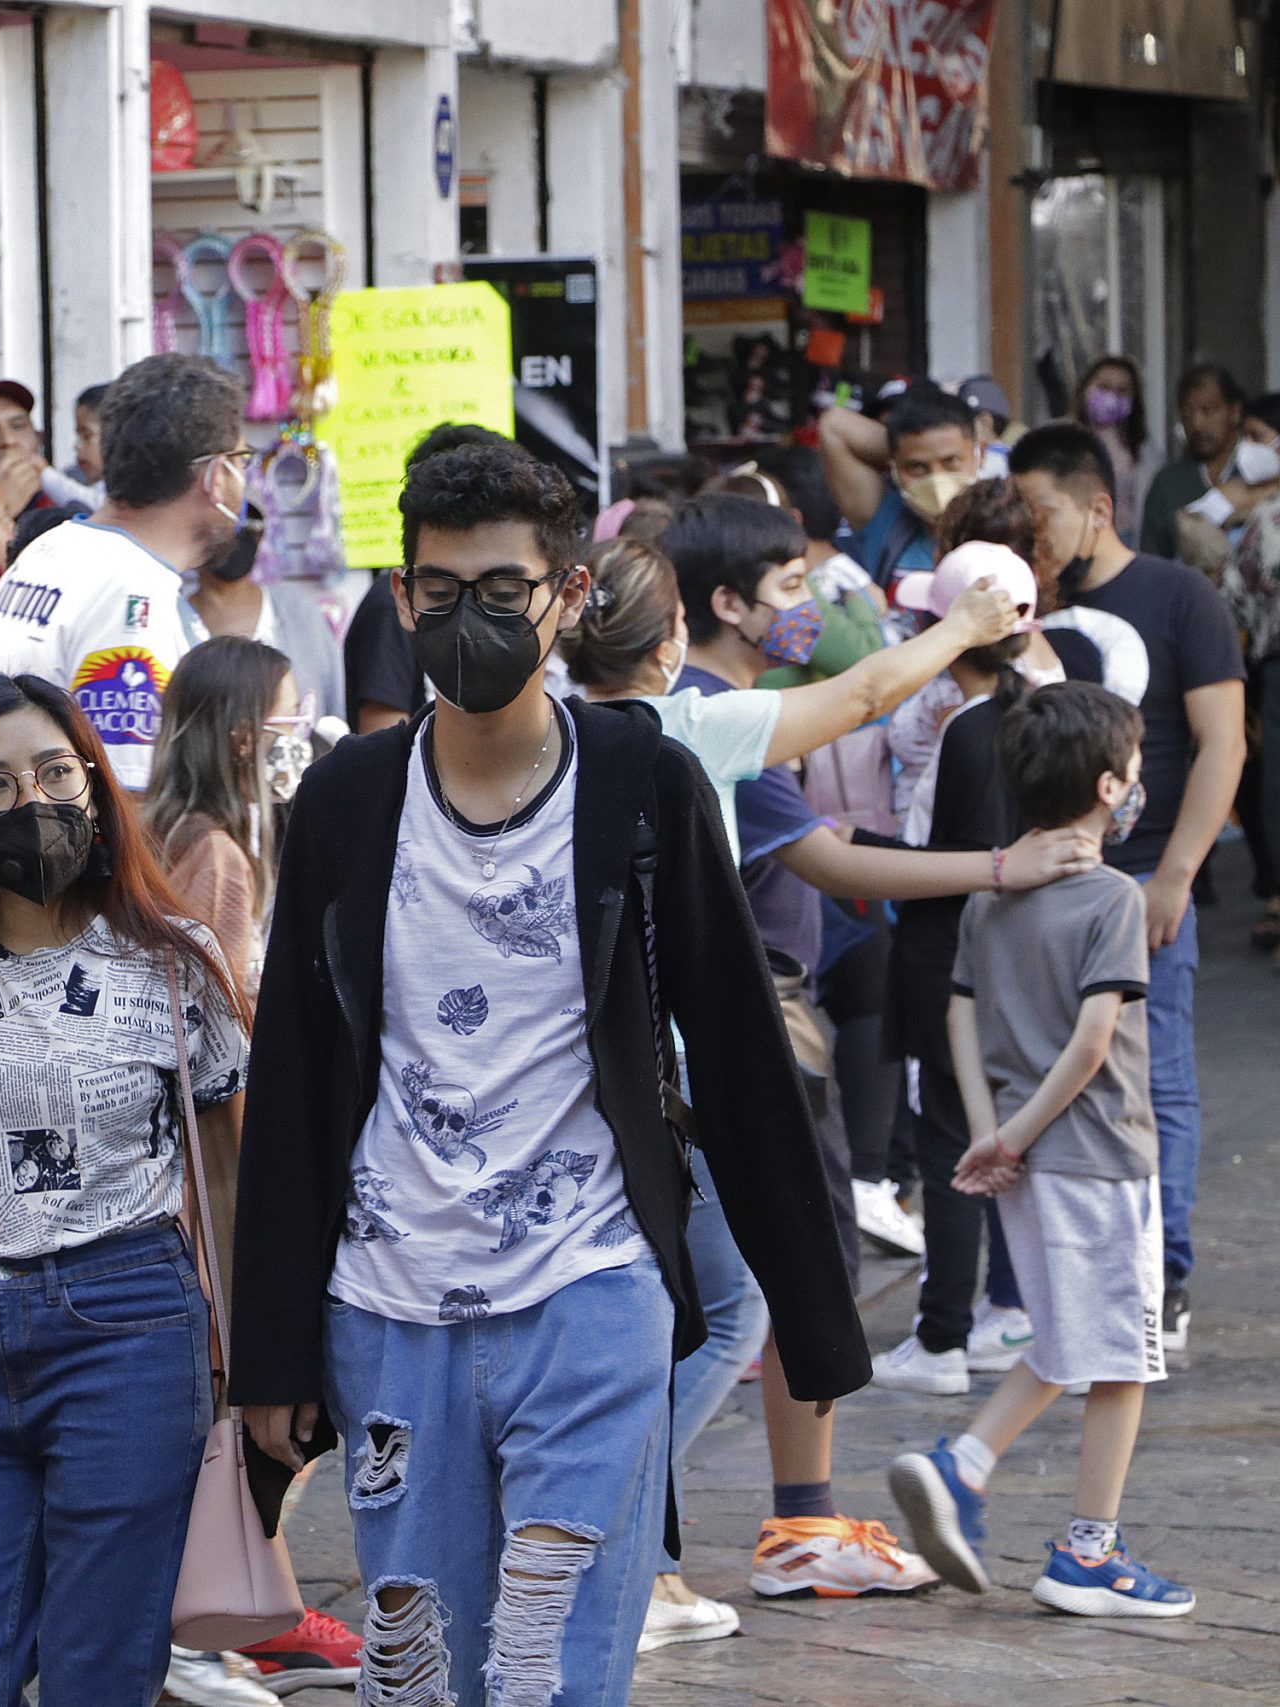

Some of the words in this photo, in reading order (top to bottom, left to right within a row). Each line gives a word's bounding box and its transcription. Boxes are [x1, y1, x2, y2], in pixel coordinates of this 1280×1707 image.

[521, 354, 572, 388] EN
[75, 689, 162, 712] CLEMEN
[32, 971, 63, 989] October
[113, 996, 126, 1010] in
[114, 1015, 153, 1034] Enviro
[78, 1069, 126, 1089] Pressurfor
[80, 1091, 92, 1103] By
[94, 1083, 130, 1100] Agroing
[130, 1079, 139, 1090] to
[84, 1101, 117, 1115] Gambb
[118, 1096, 129, 1106] on
[130, 1089, 143, 1102] His
[50, 1196, 65, 1209] of
[53, 1214, 63, 1223] in
